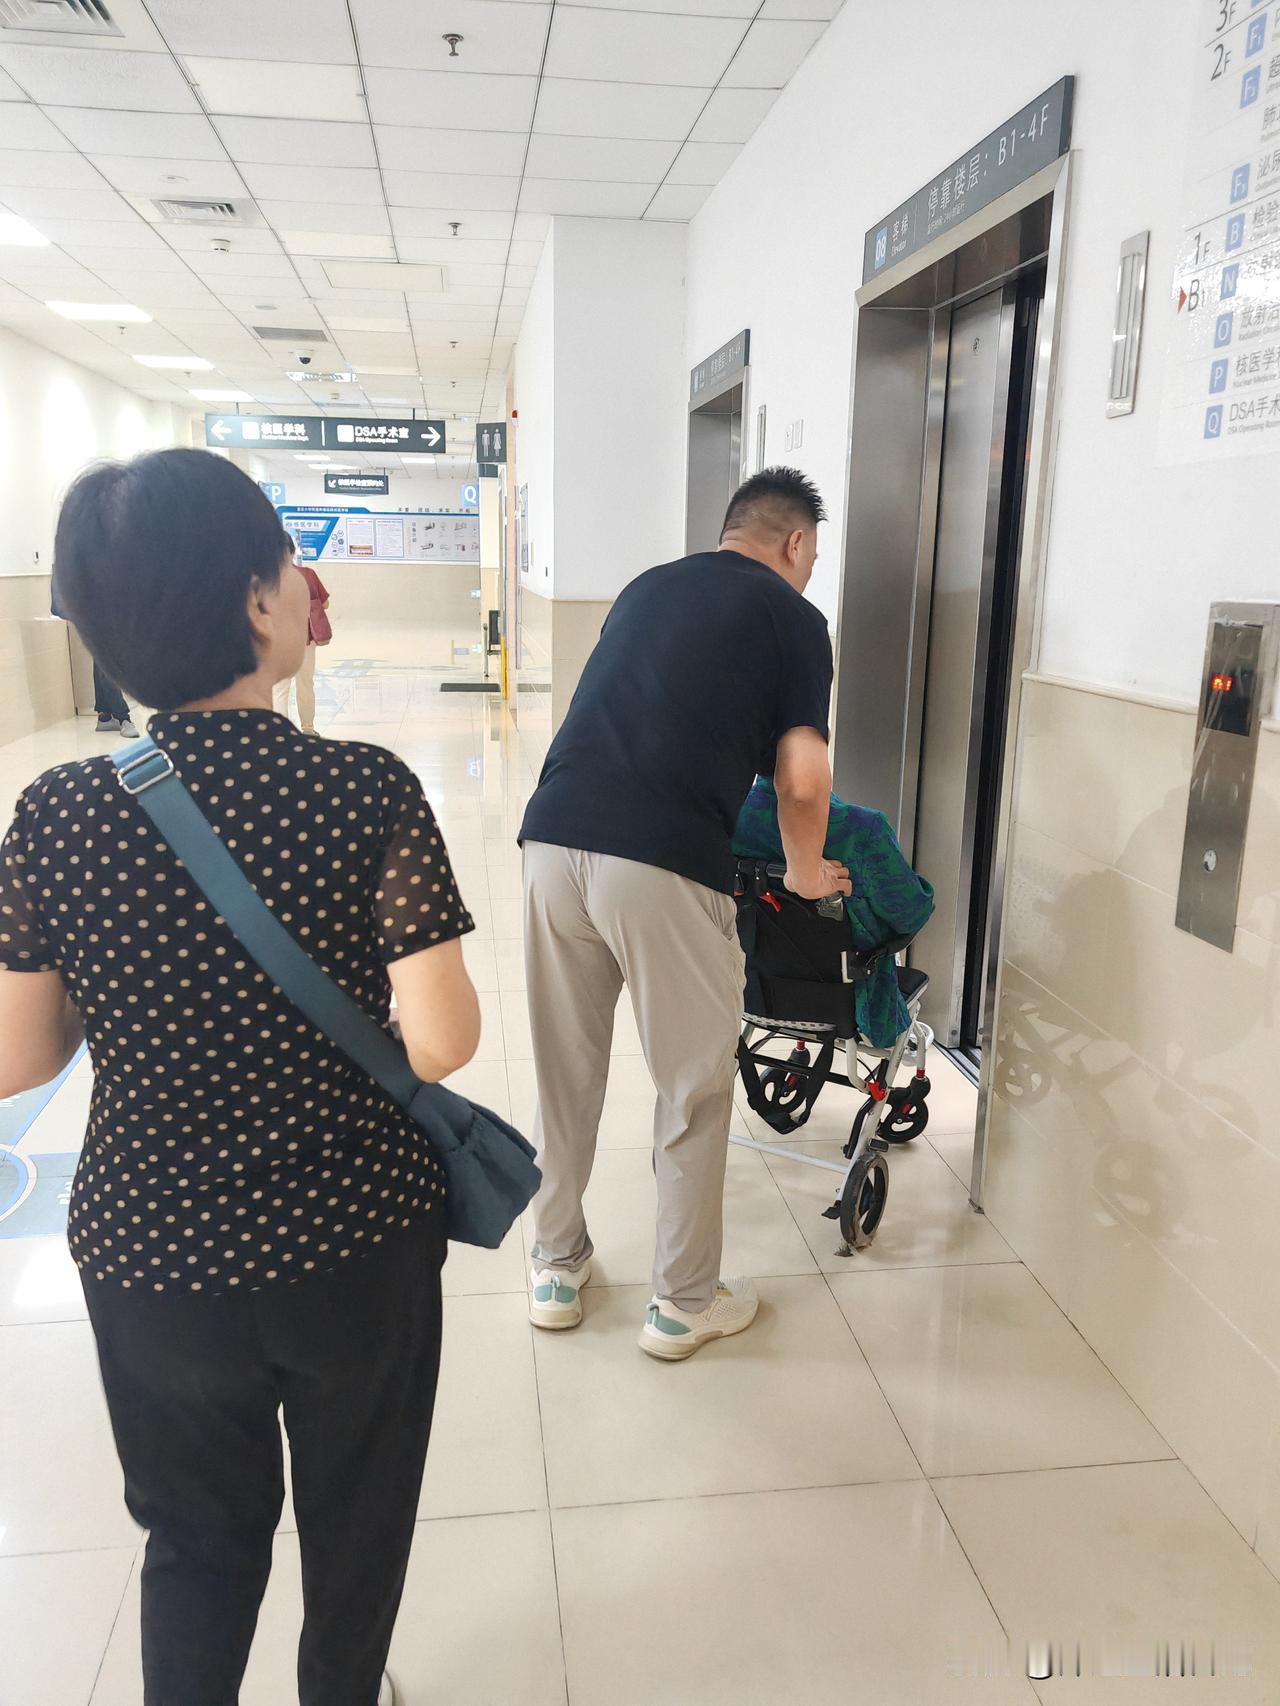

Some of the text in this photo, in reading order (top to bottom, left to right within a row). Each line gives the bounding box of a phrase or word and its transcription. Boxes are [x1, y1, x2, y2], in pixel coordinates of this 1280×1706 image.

[1216, 0, 1236, 32] 3F
[1211, 44, 1231, 81] 2F
[1230, 221, 1240, 246] B
[876, 235, 887, 261] 08
[1194, 232, 1211, 266] 1F
[1187, 278, 1206, 312] B1
[1222, 272, 1236, 297] N
[1213, 371, 1223, 389] P
[354, 425, 409, 439] DSA手术室
[1207, 411, 1219, 435] Q
[271, 485, 282, 501] P
[464, 486, 477, 504] Q
